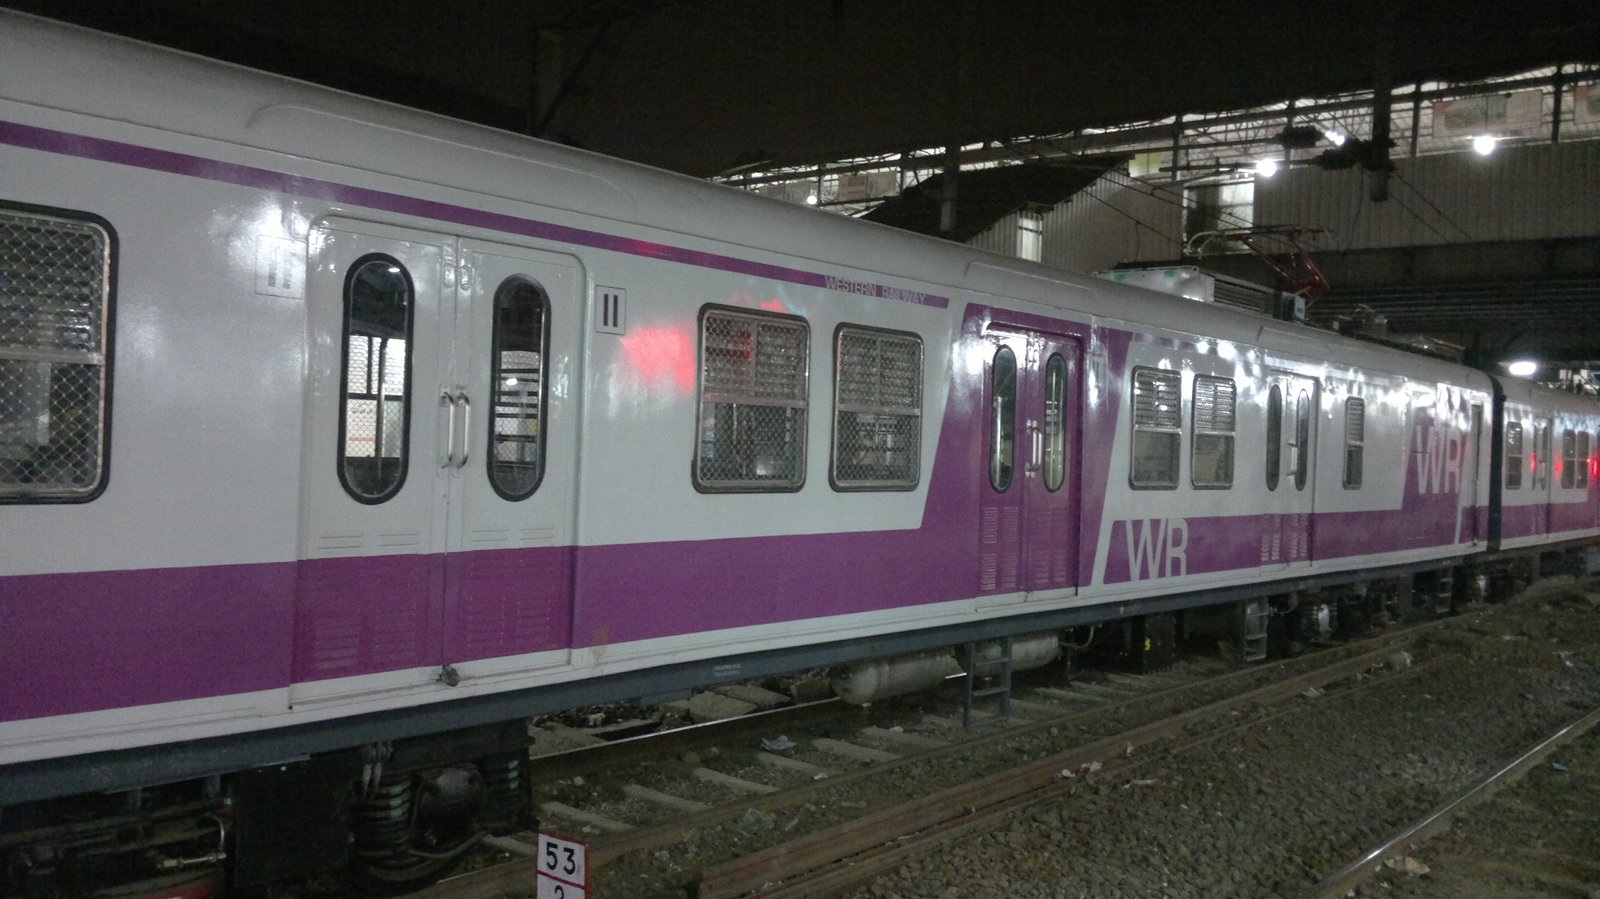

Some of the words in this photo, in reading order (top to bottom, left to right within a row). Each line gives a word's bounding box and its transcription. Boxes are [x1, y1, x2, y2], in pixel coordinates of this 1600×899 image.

[824, 276, 877, 297] WESTERN
[881, 285, 926, 305] RAILWAY
[1416, 424, 1462, 494] WR
[1125, 517, 1189, 580] WR
[546, 842, 576, 875] 53
